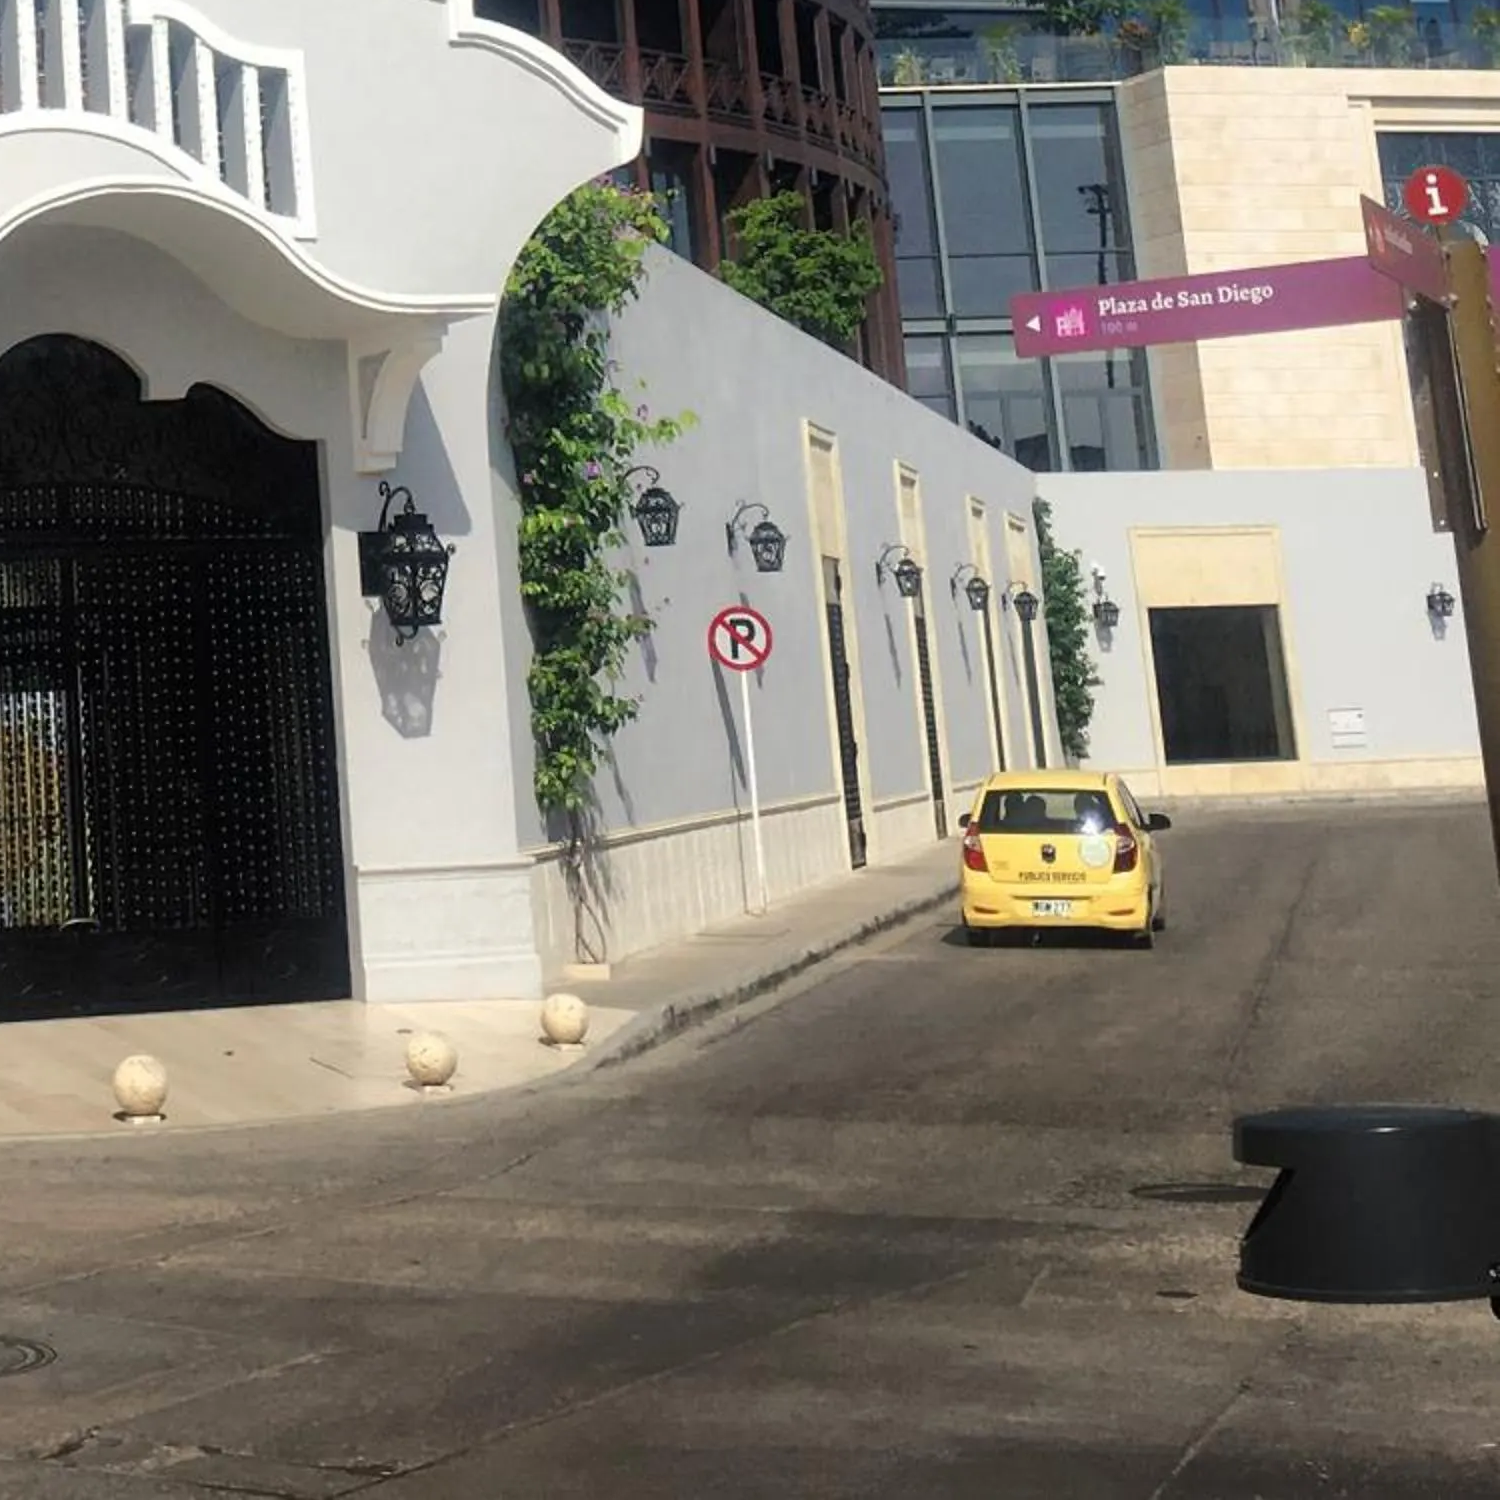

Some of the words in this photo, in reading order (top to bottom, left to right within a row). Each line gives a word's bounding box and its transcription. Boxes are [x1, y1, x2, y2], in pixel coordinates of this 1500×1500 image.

[1097, 296, 1149, 317] Plaza
[1151, 292, 1174, 310] de
[1177, 290, 1214, 308] San
[1217, 283, 1274, 304] Diego
